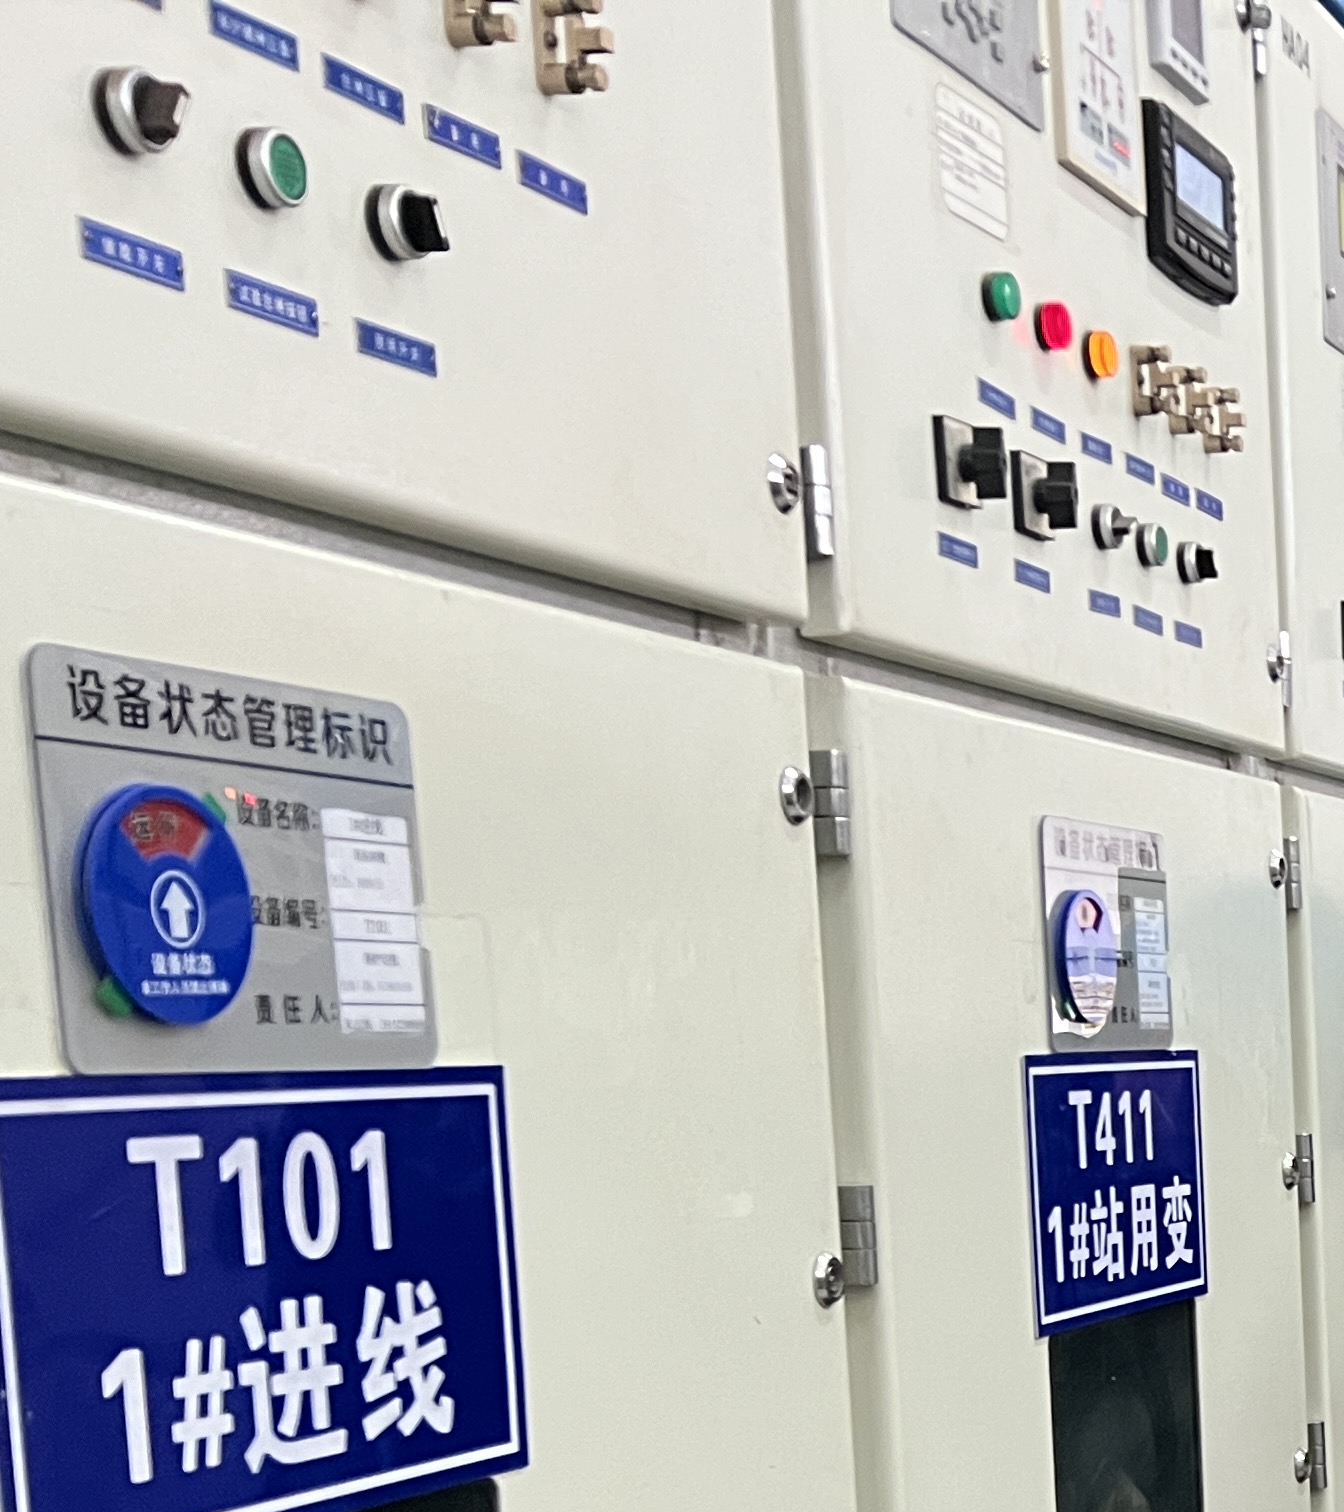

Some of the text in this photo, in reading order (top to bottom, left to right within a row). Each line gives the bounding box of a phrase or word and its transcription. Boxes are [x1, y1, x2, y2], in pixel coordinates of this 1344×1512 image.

[66, 664, 395, 766] 设备状态管理标识
[1068, 1088, 1156, 1169] T411
[126, 1129, 392, 1276] T101
[1047, 1175, 1194, 1283] 1#站用变
[101, 1279, 455, 1485] 1#进线
